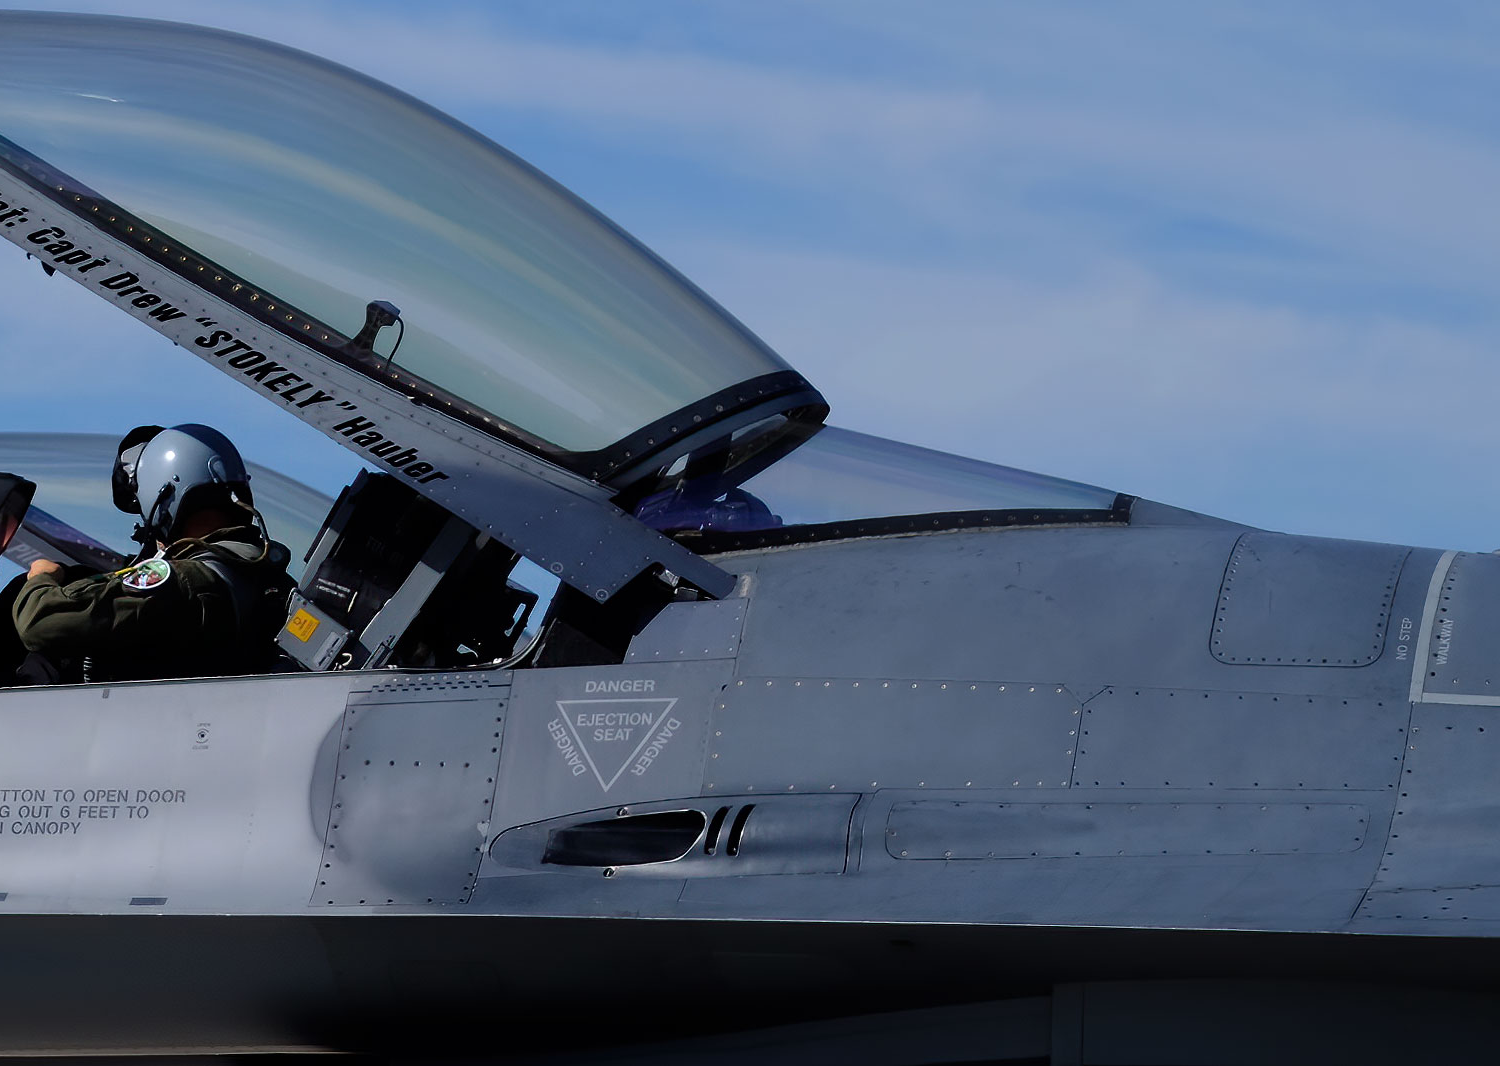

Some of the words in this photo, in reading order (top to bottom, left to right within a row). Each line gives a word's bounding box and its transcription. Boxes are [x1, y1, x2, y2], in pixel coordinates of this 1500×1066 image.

[26, 226, 111, 274] Capt
[99, 271, 188, 322] Drew
[332, 415, 450, 484] Hauber
[1399, 617, 1412, 641] STEP
[1436, 618, 1454, 665] WALKWAY
[1396, 644, 1408, 660] NO
[585, 679, 655, 693] DANGER
[577, 712, 653, 726] EJECTION
[593, 727, 633, 741] SEAT
[547, 718, 587, 776] DANGER
[631, 717, 682, 776] DANGER
[53, 788, 76, 803] TO
[83, 788, 129, 803] OPEN
[135, 788, 186, 803] DOOR
[18, 805, 53, 818] OUT
[60, 805, 70, 818] 6
[78, 805, 120, 818] FEET
[127, 805, 149, 818] TO
[11, 821, 81, 835] CANOPY
